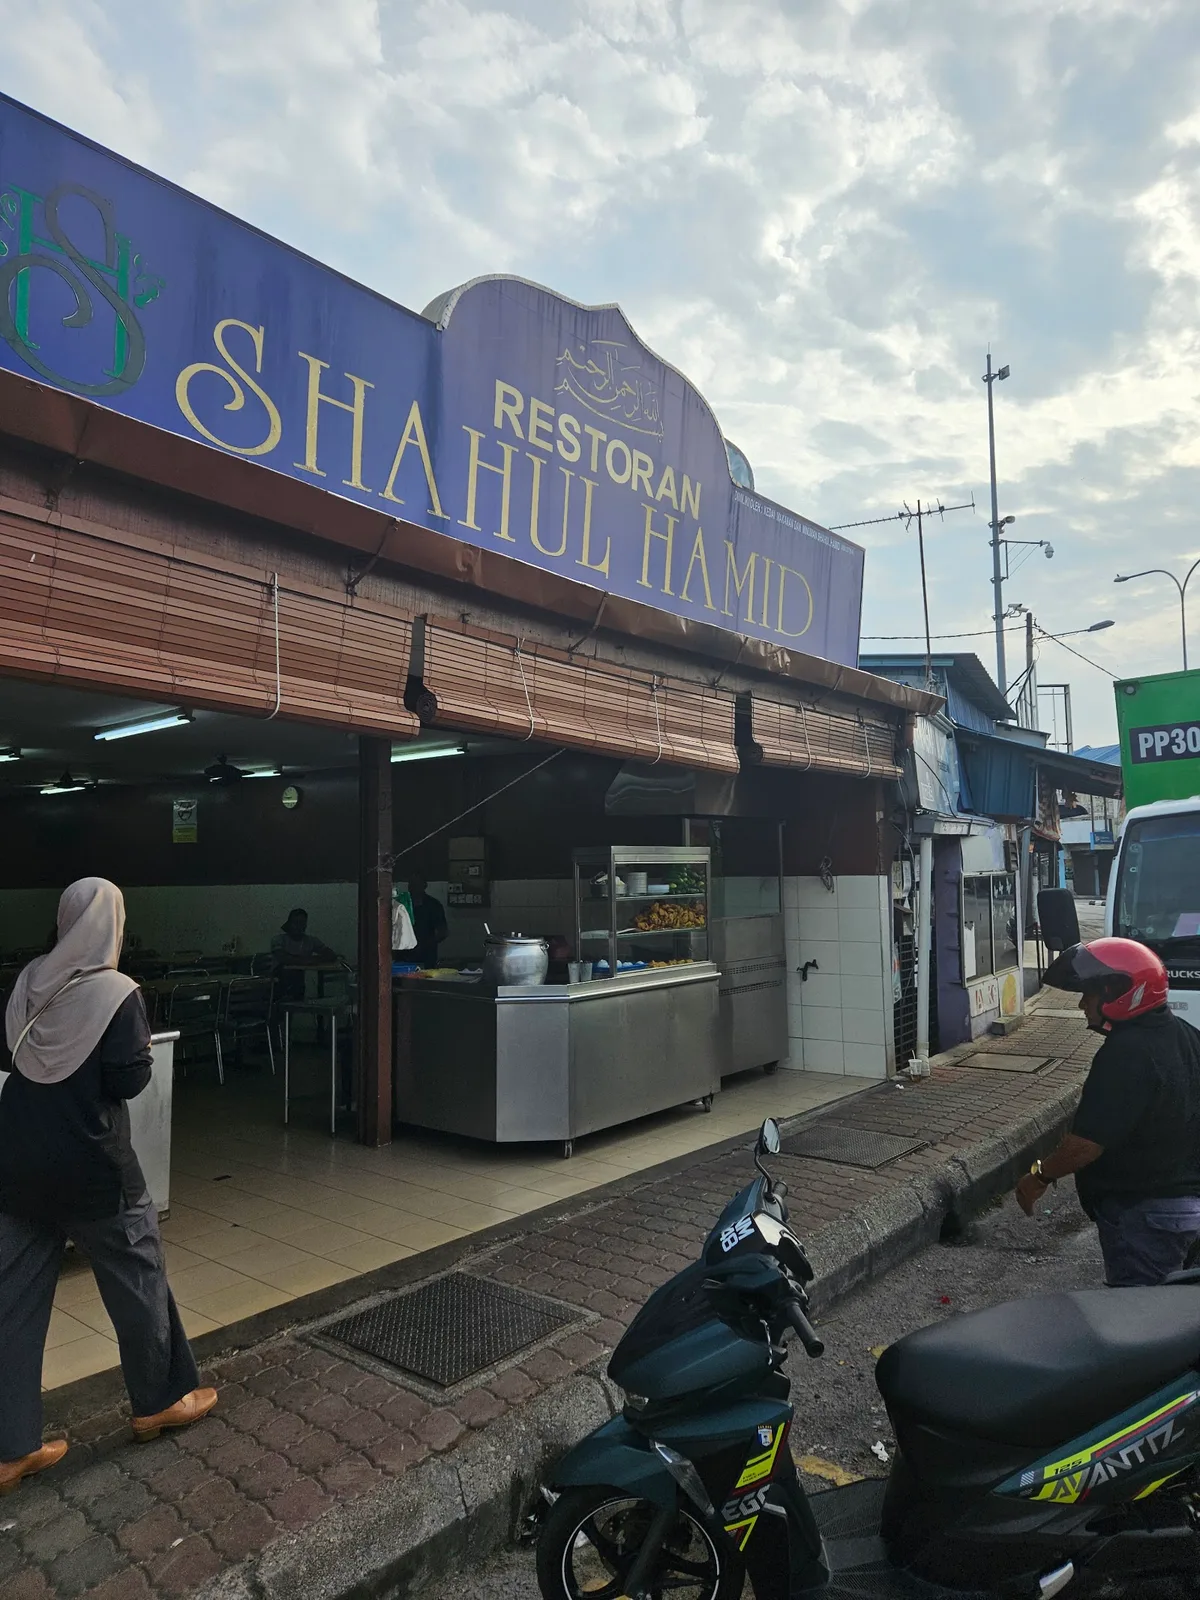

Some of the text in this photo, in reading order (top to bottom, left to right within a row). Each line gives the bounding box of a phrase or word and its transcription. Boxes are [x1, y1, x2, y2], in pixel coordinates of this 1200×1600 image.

[175, 318, 814, 638] SHAHUL HAMID
[493, 378, 702, 520] RESTORAN
[1054, 1458, 1083, 1475] 125
